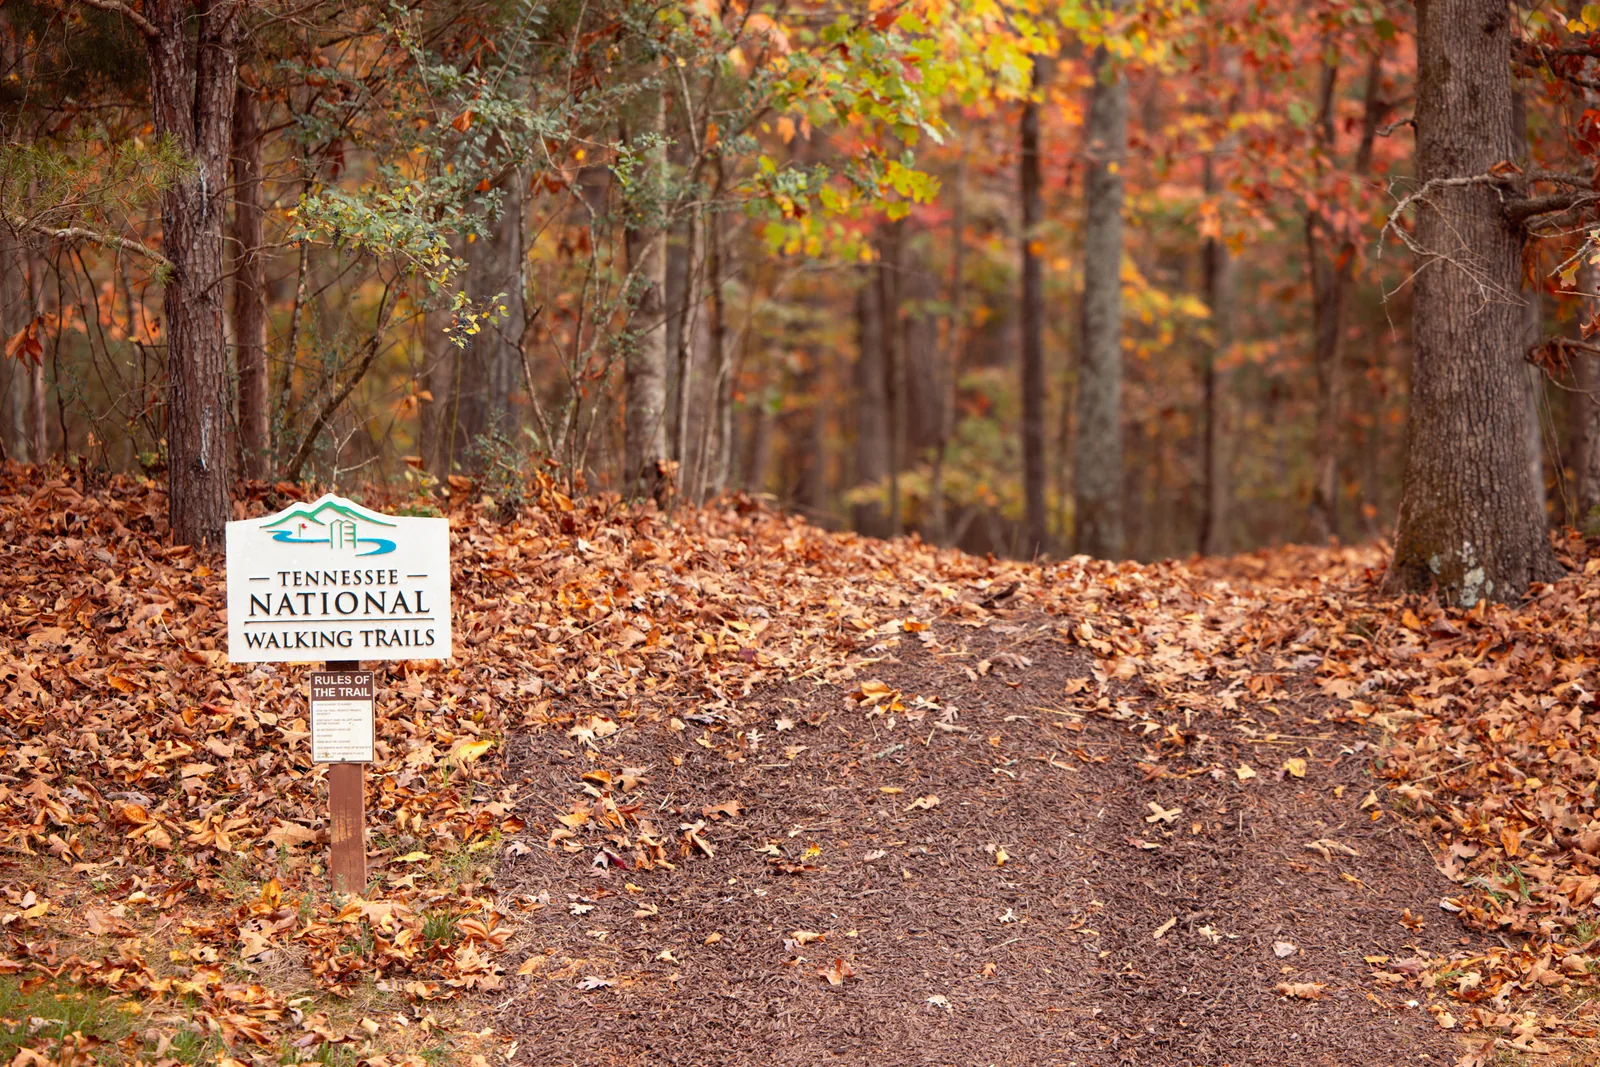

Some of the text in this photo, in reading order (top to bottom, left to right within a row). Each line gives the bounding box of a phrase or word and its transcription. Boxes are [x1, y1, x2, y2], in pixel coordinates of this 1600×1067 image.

[278, 569, 398, 587] TENNESSEE
[249, 590, 430, 617] NATIONAL
[244, 629, 435, 649] WALKING TRAILS
[314, 675, 370, 685] RULES OF
[314, 687, 371, 697] THE TRAIL
